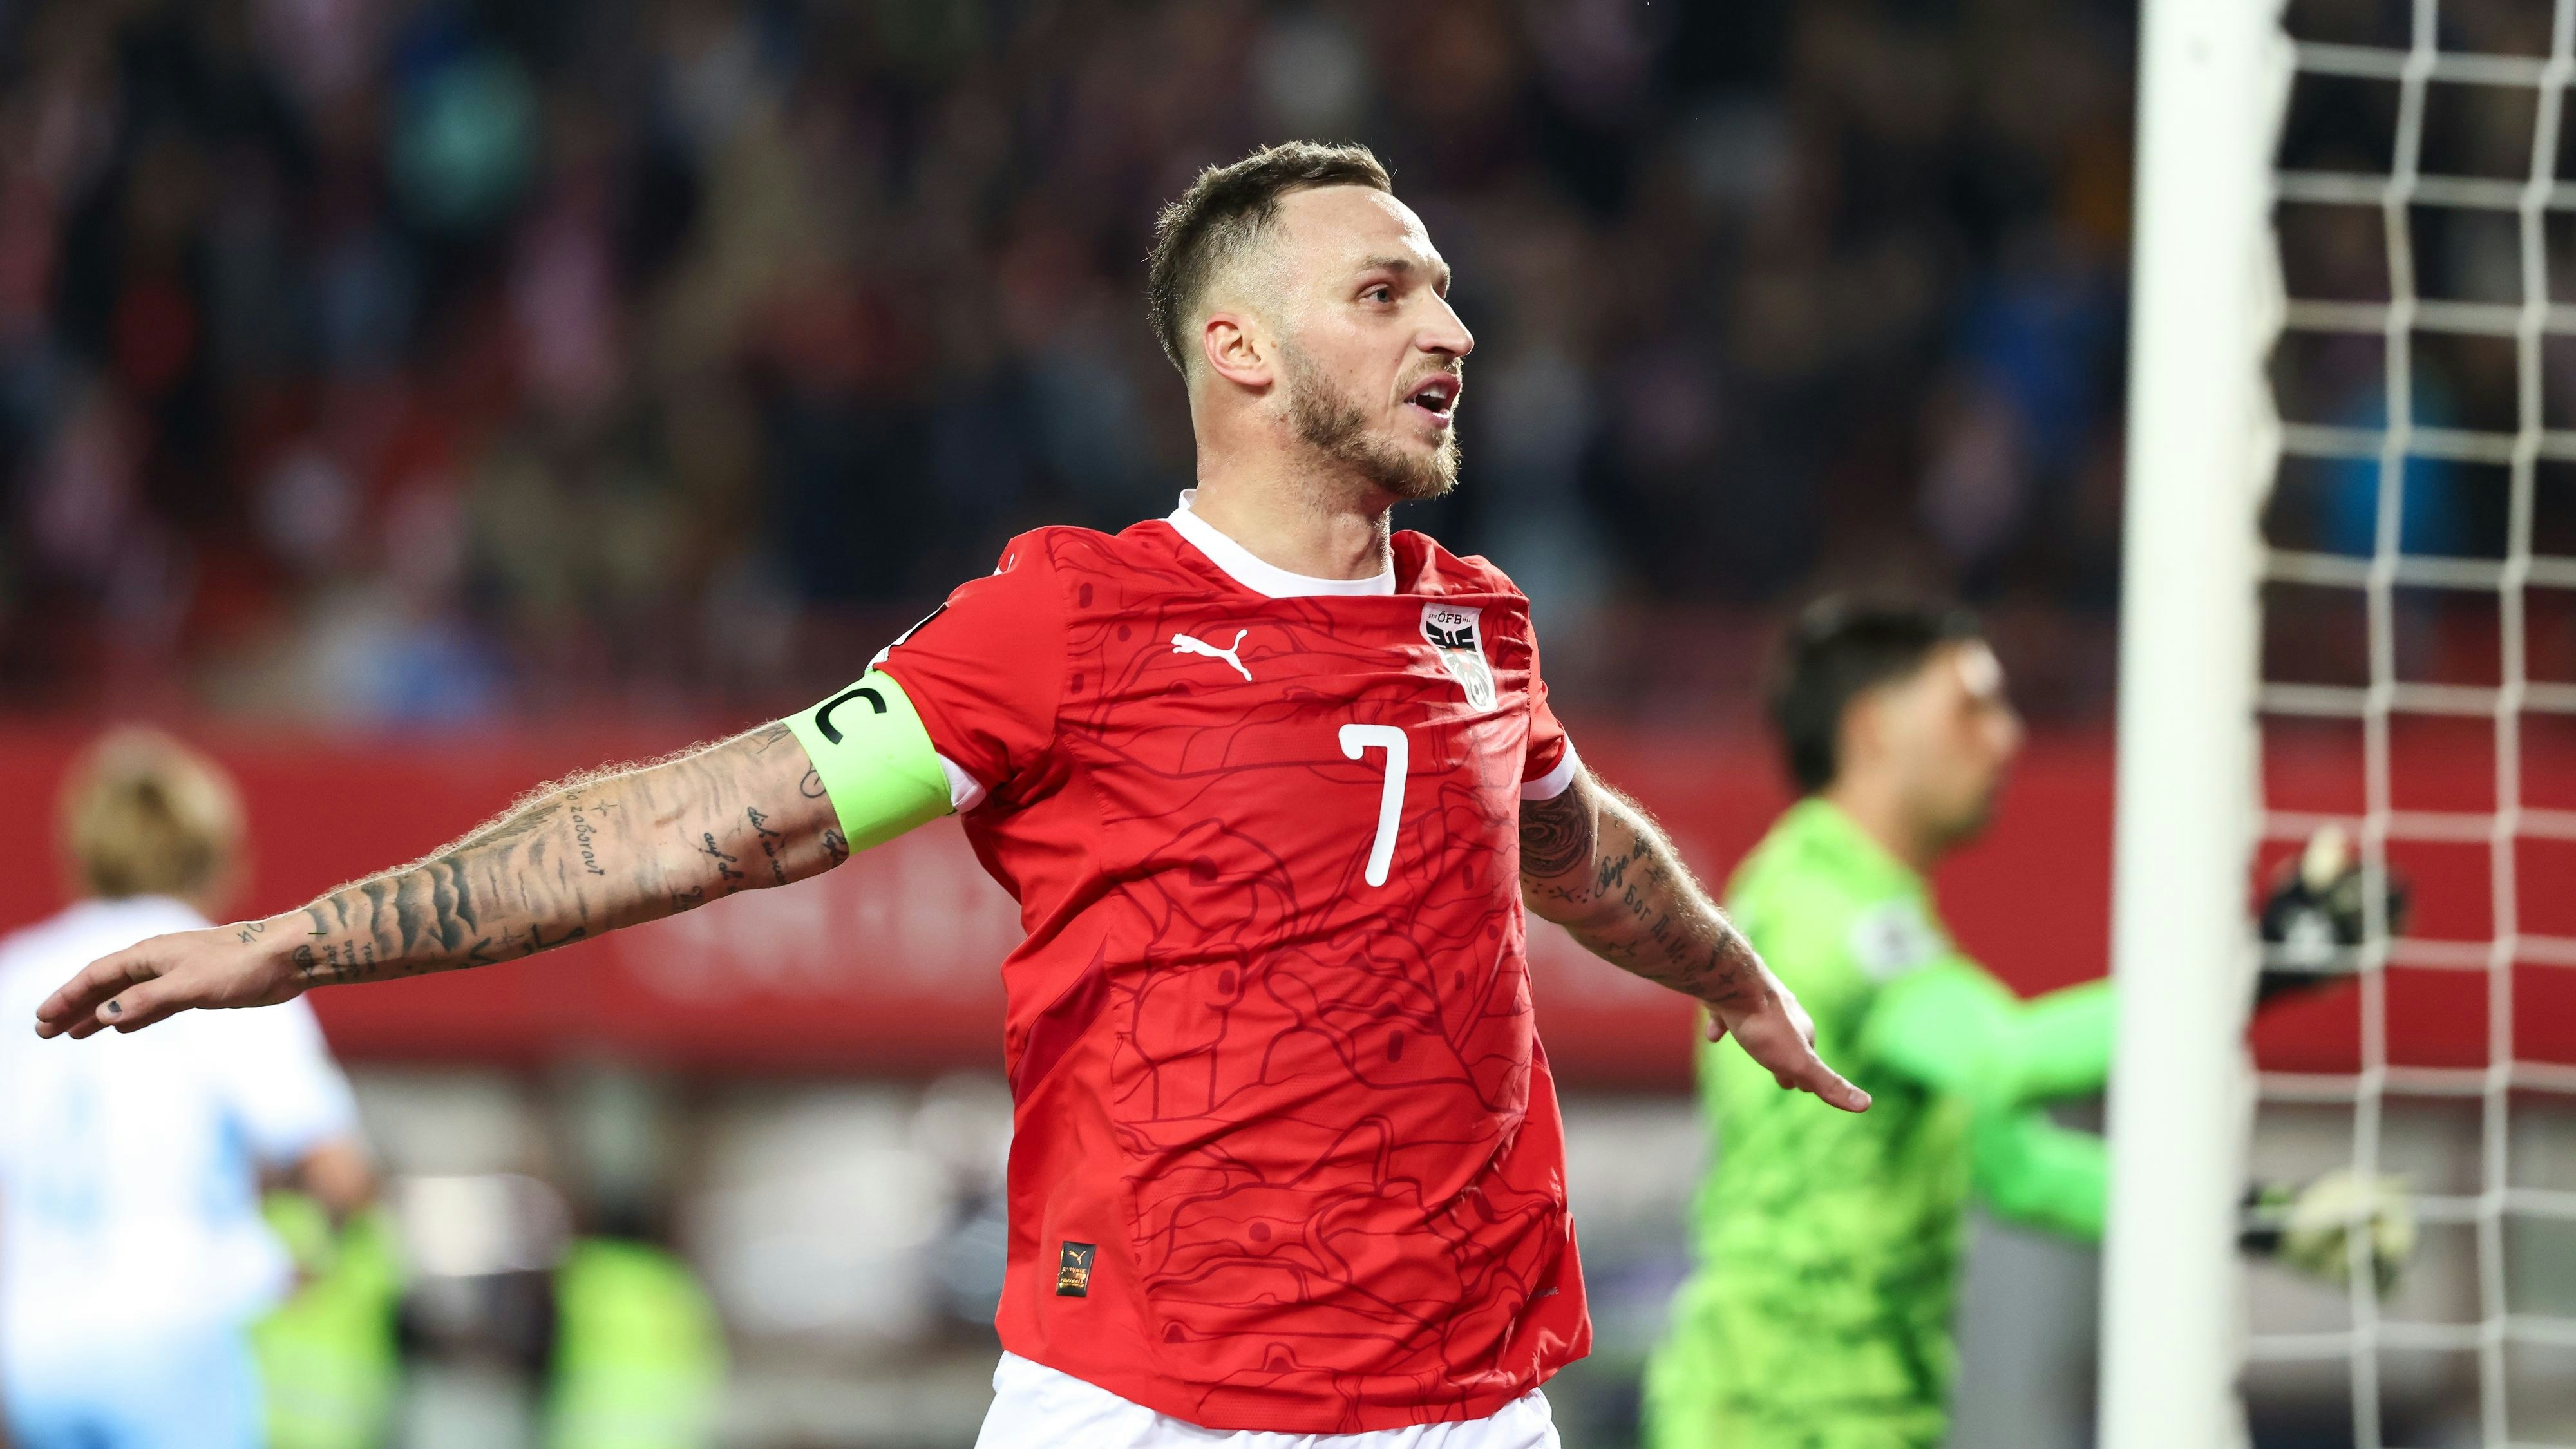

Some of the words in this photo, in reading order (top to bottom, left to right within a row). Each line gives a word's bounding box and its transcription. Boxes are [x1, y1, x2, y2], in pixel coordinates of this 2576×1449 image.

[1437, 611, 1463, 625] ÖFB
[815, 688, 887, 745] C
[1338, 723, 1409, 887] 7
